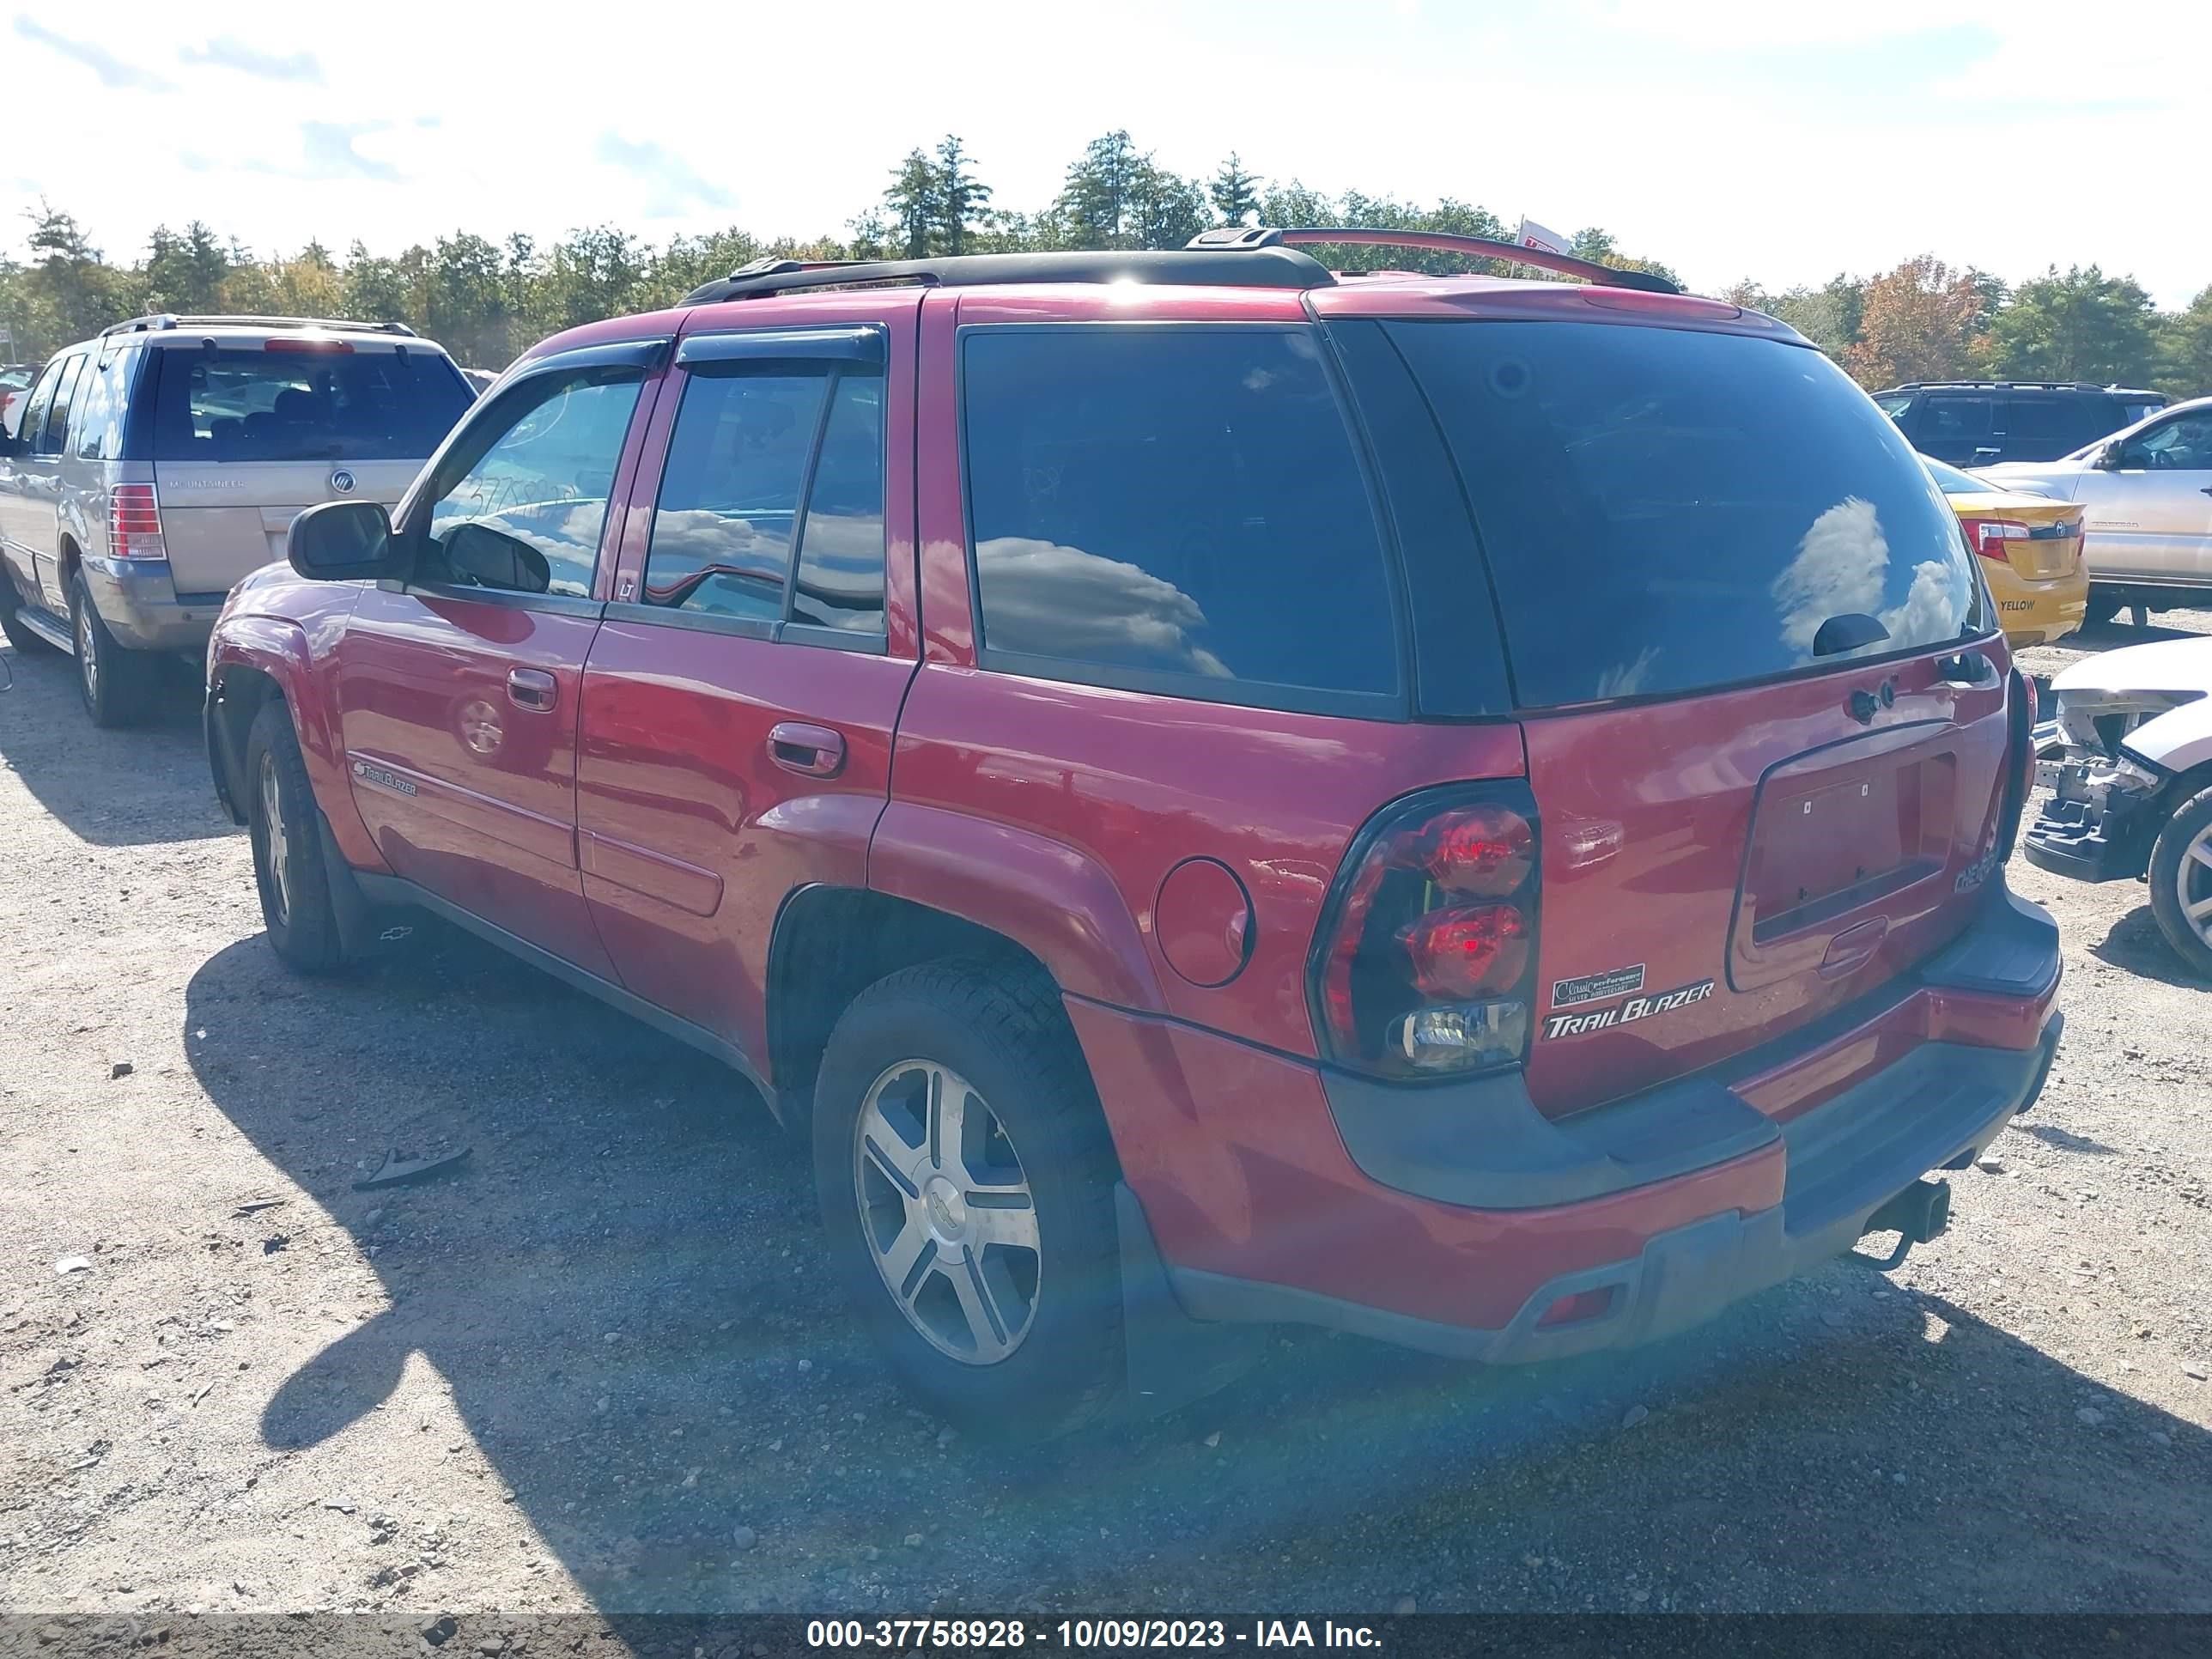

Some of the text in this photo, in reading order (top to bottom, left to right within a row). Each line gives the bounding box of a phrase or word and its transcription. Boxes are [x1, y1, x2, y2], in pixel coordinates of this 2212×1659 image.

[619, 583, 635, 598] LT
[2001, 599, 2035, 611] YELLOW
[1549, 981, 1716, 1039] TRAILBLAZER
